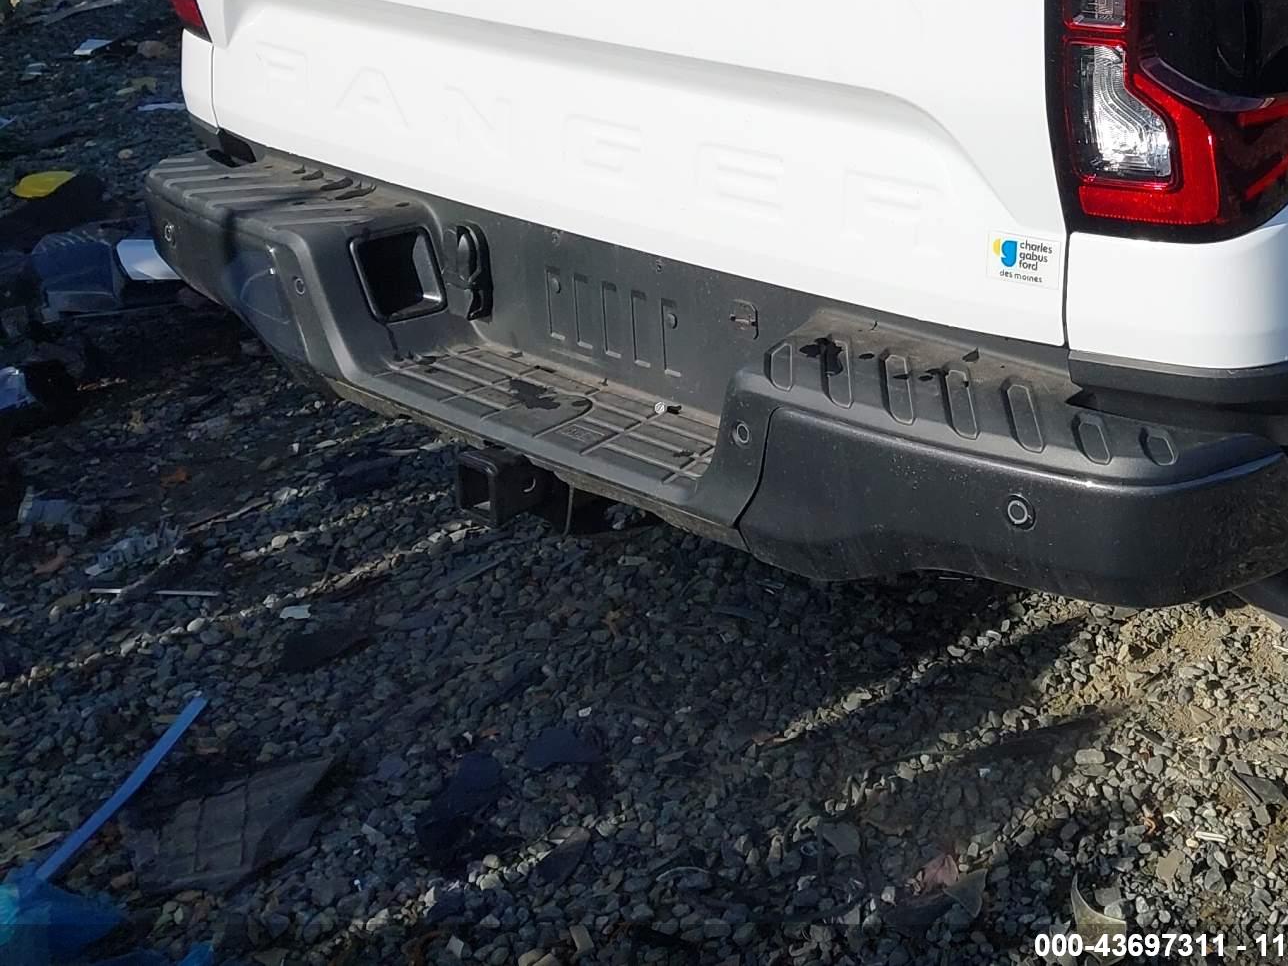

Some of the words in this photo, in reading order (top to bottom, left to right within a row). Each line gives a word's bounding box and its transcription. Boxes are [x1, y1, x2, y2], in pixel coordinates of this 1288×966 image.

[255, 41, 958, 256] RANGER
[1019, 240, 1053, 254] charles
[1019, 251, 1049, 263] gabus
[1018, 260, 1039, 271] ford
[999, 269, 1014, 278] des
[1014, 273, 1043, 283] moines
